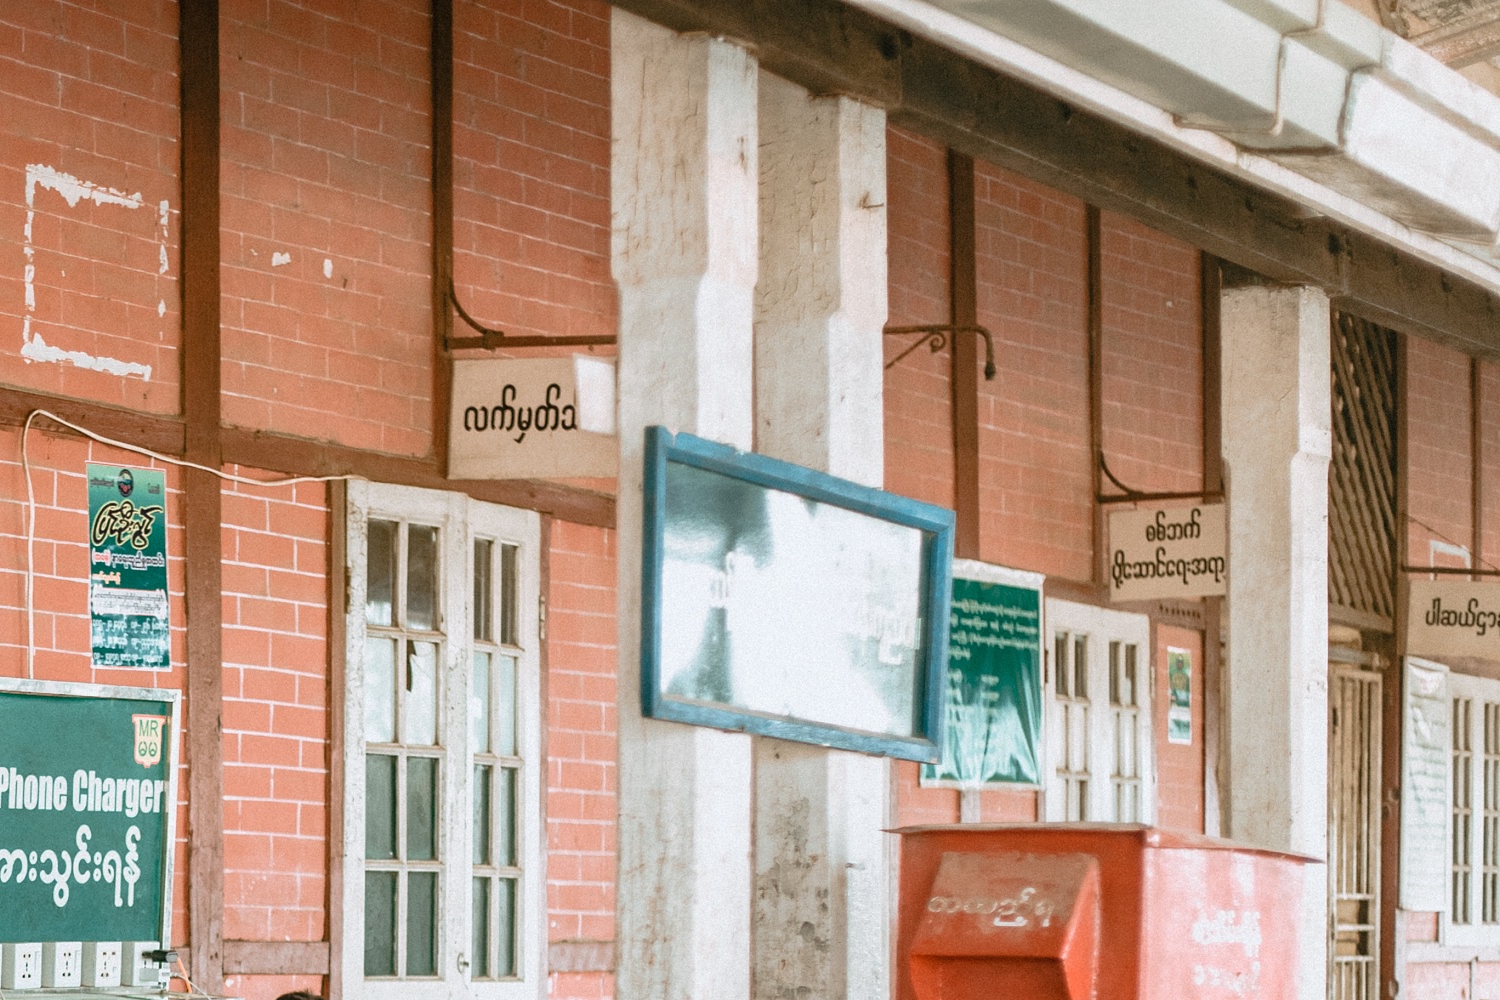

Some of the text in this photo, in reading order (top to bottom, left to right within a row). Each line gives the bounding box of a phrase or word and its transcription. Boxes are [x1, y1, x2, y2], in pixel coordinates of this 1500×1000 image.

[1425, 597, 1500, 636] ပါဆယ်ဌာ
[139, 719, 159, 738] MR
[72, 768, 165, 818] Charger
